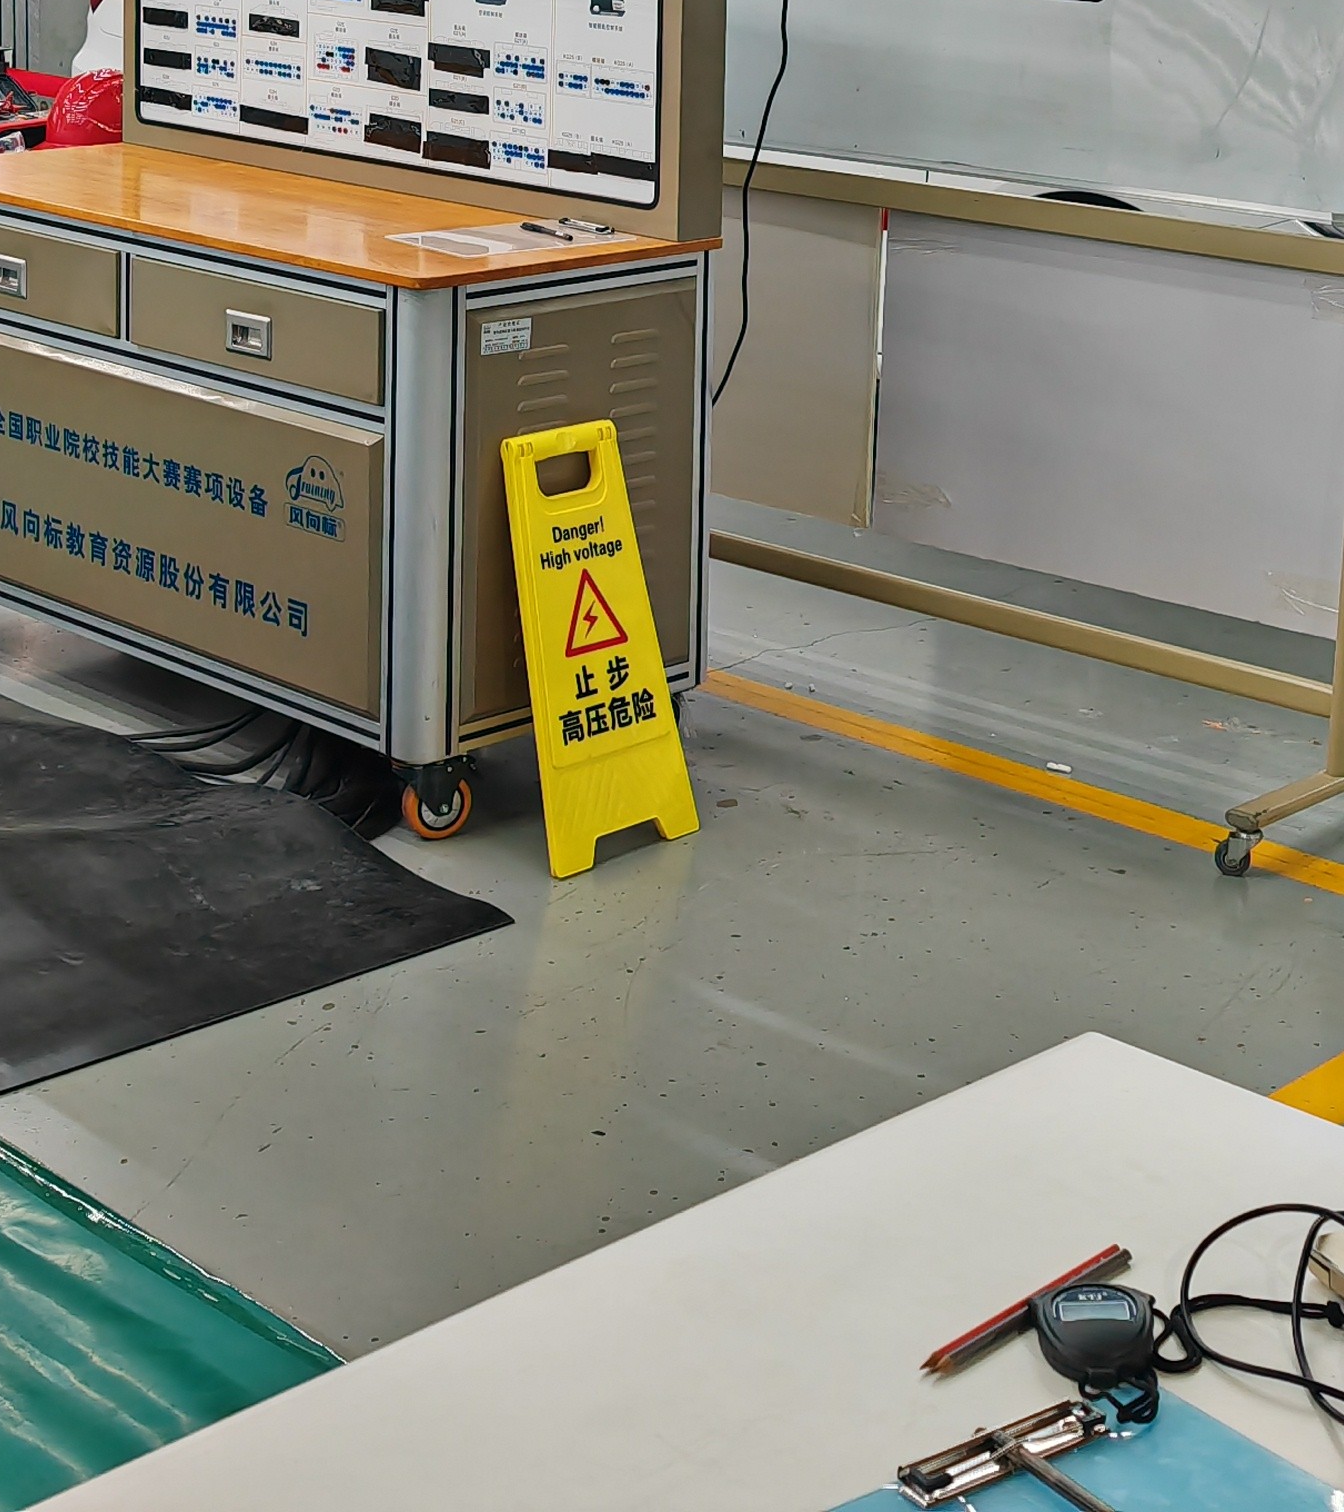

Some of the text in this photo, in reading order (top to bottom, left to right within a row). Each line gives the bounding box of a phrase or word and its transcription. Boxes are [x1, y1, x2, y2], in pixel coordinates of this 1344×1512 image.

[552, 515, 605, 544] Danger!
[540, 539, 623, 571] High voltage
[575, 655, 630, 700] 止步
[558, 688, 657, 747] 高压危险
